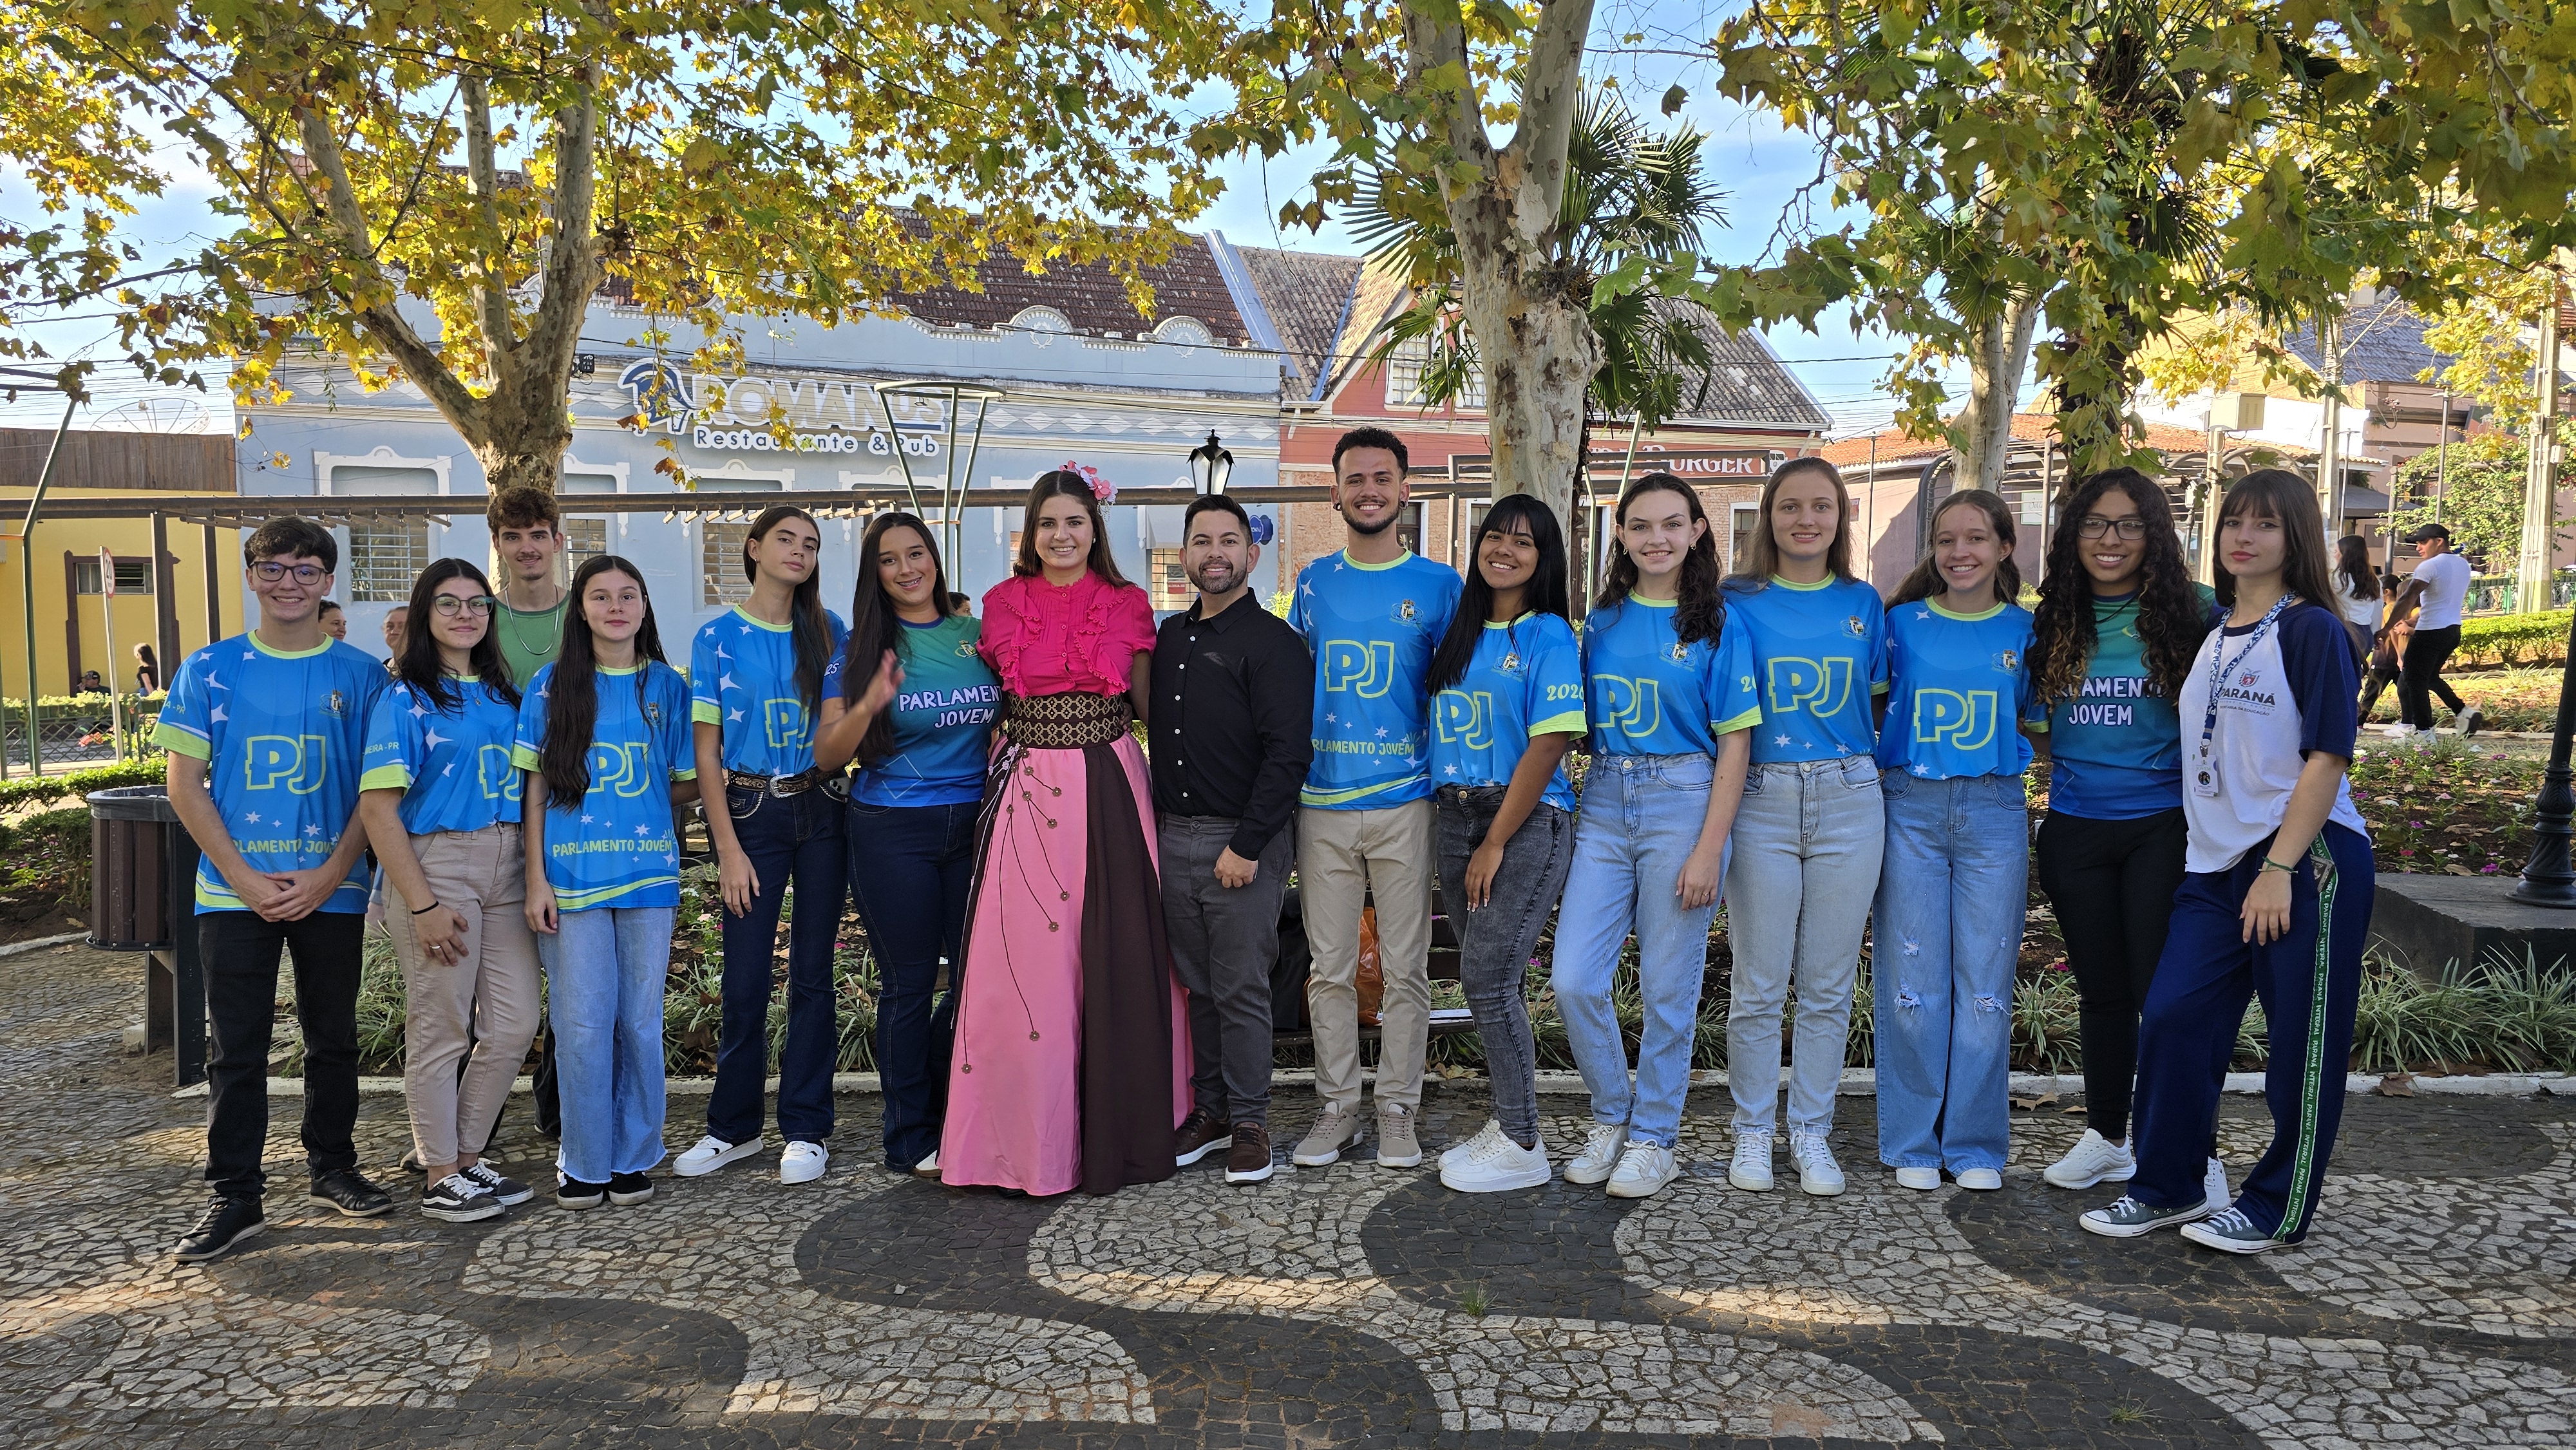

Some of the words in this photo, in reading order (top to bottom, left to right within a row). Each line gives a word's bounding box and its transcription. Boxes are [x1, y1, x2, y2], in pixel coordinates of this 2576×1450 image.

[696, 378, 943, 428] ROMANUS
[697, 429, 855, 450] Restaunte
[873, 436, 889, 451] &
[105, 558, 112, 580] 20
[1325, 639, 1394, 699] PJ
[1767, 657, 1853, 717] PJ
[899, 685, 1003, 711] PARLAMENT
[1592, 673, 1658, 737] PJ
[2069, 704, 2132, 726] JOVEM
[934, 708, 994, 728] JOVEM
[1436, 690, 1493, 750] PJ
[1913, 688, 1997, 750] PJ
[245, 734, 326, 795] PJ
[1311, 739, 1376, 755] RLAMENTO
[1378, 742, 1415, 755] JOVEM
[584, 742, 650, 797] PJ
[553, 839, 635, 857] PARLAMENTO
[638, 839, 672, 852] JOVEM
[2287, 1198, 2300, 1223] INTEGRAL
